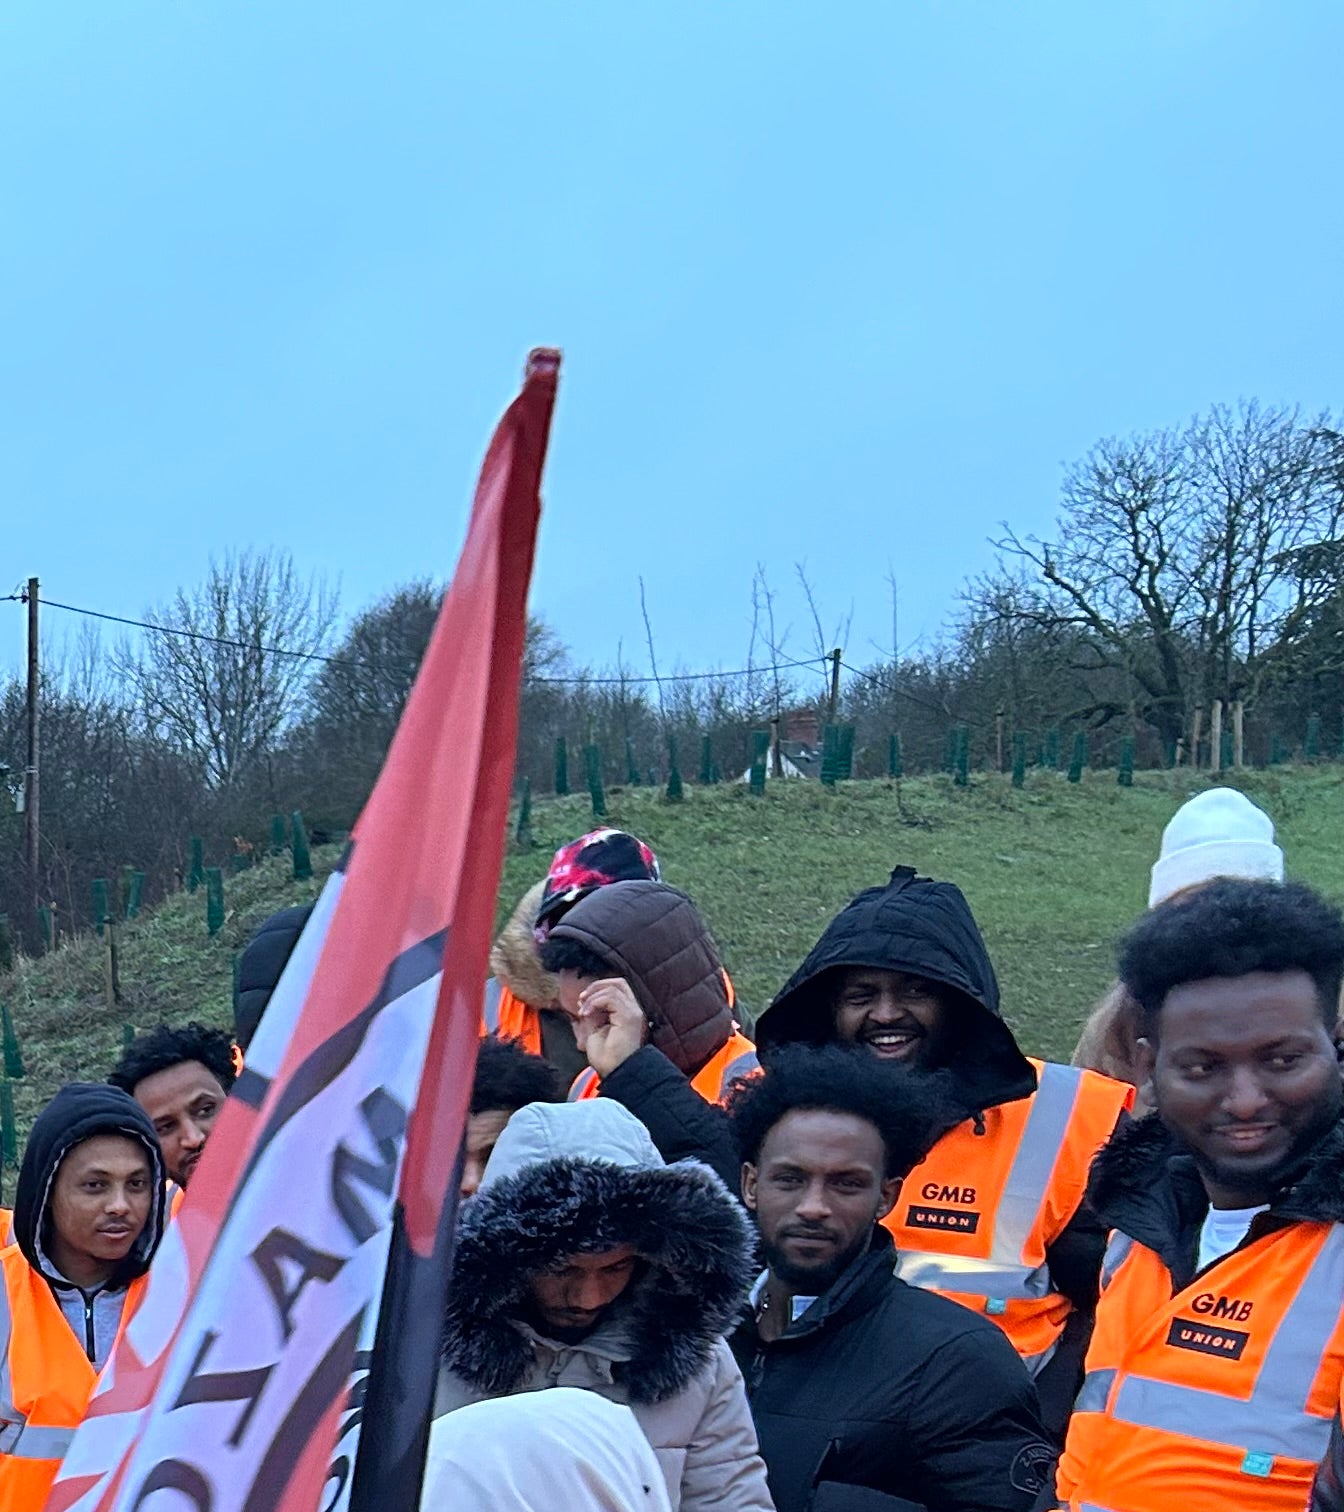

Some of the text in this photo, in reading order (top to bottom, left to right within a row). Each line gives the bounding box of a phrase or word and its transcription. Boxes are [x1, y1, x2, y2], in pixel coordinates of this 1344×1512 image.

[921, 1182, 977, 1204] GMB
[916, 1213, 970, 1227] UNION
[1191, 1292, 1254, 1322] GMB
[1181, 1329, 1237, 1351] UNION
